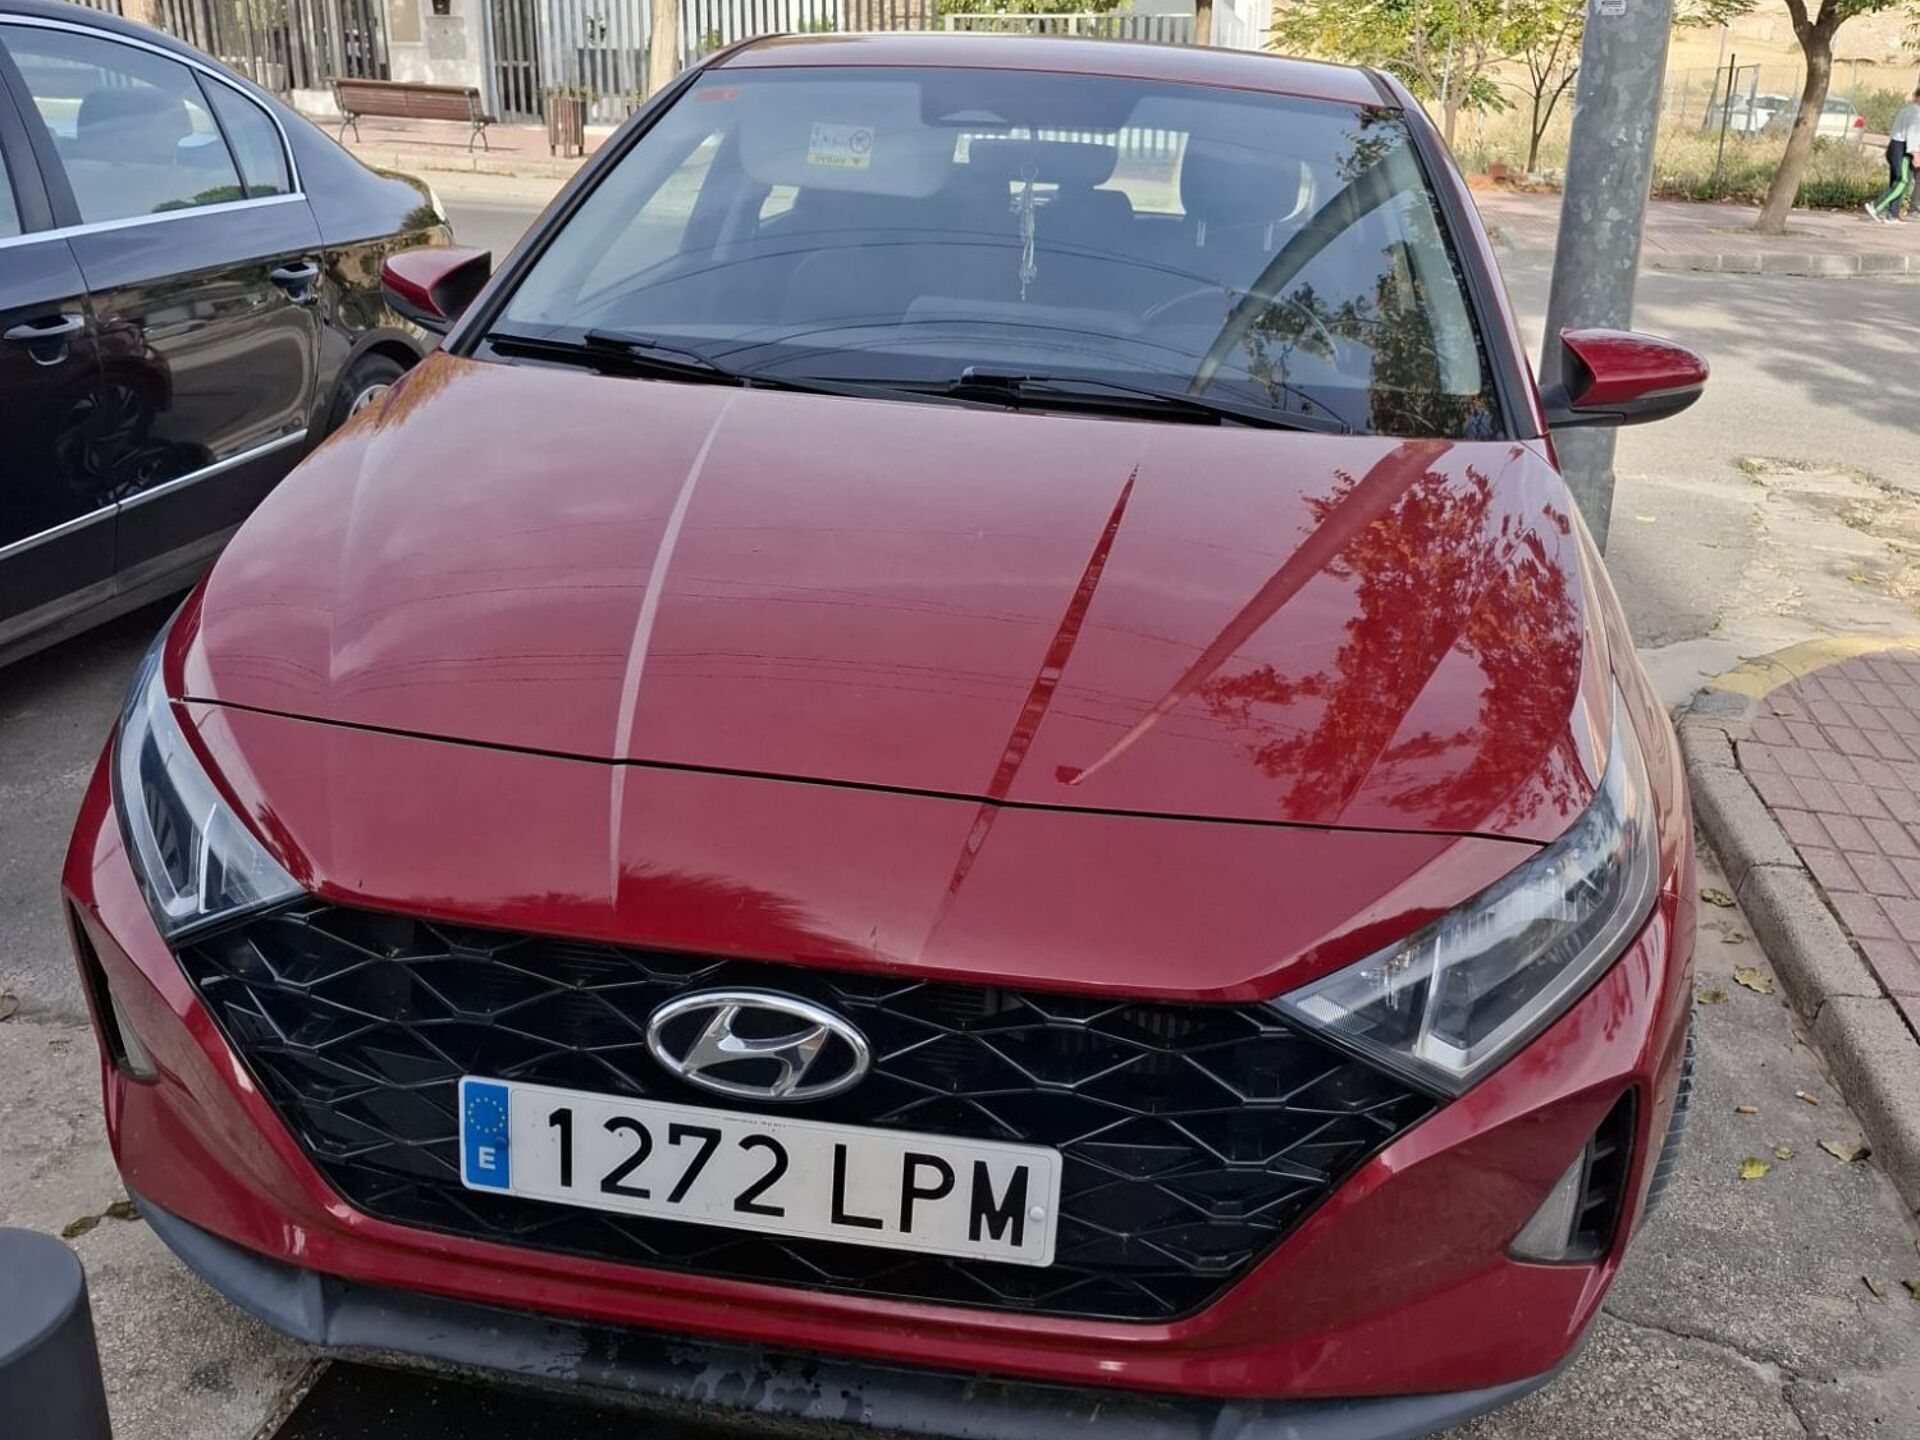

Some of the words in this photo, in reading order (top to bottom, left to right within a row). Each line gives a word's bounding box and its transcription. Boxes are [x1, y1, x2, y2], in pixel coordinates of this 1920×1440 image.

[478, 1146, 497, 1171] E
[548, 1107, 789, 1218] 1272
[830, 1143, 1030, 1248] LPM
